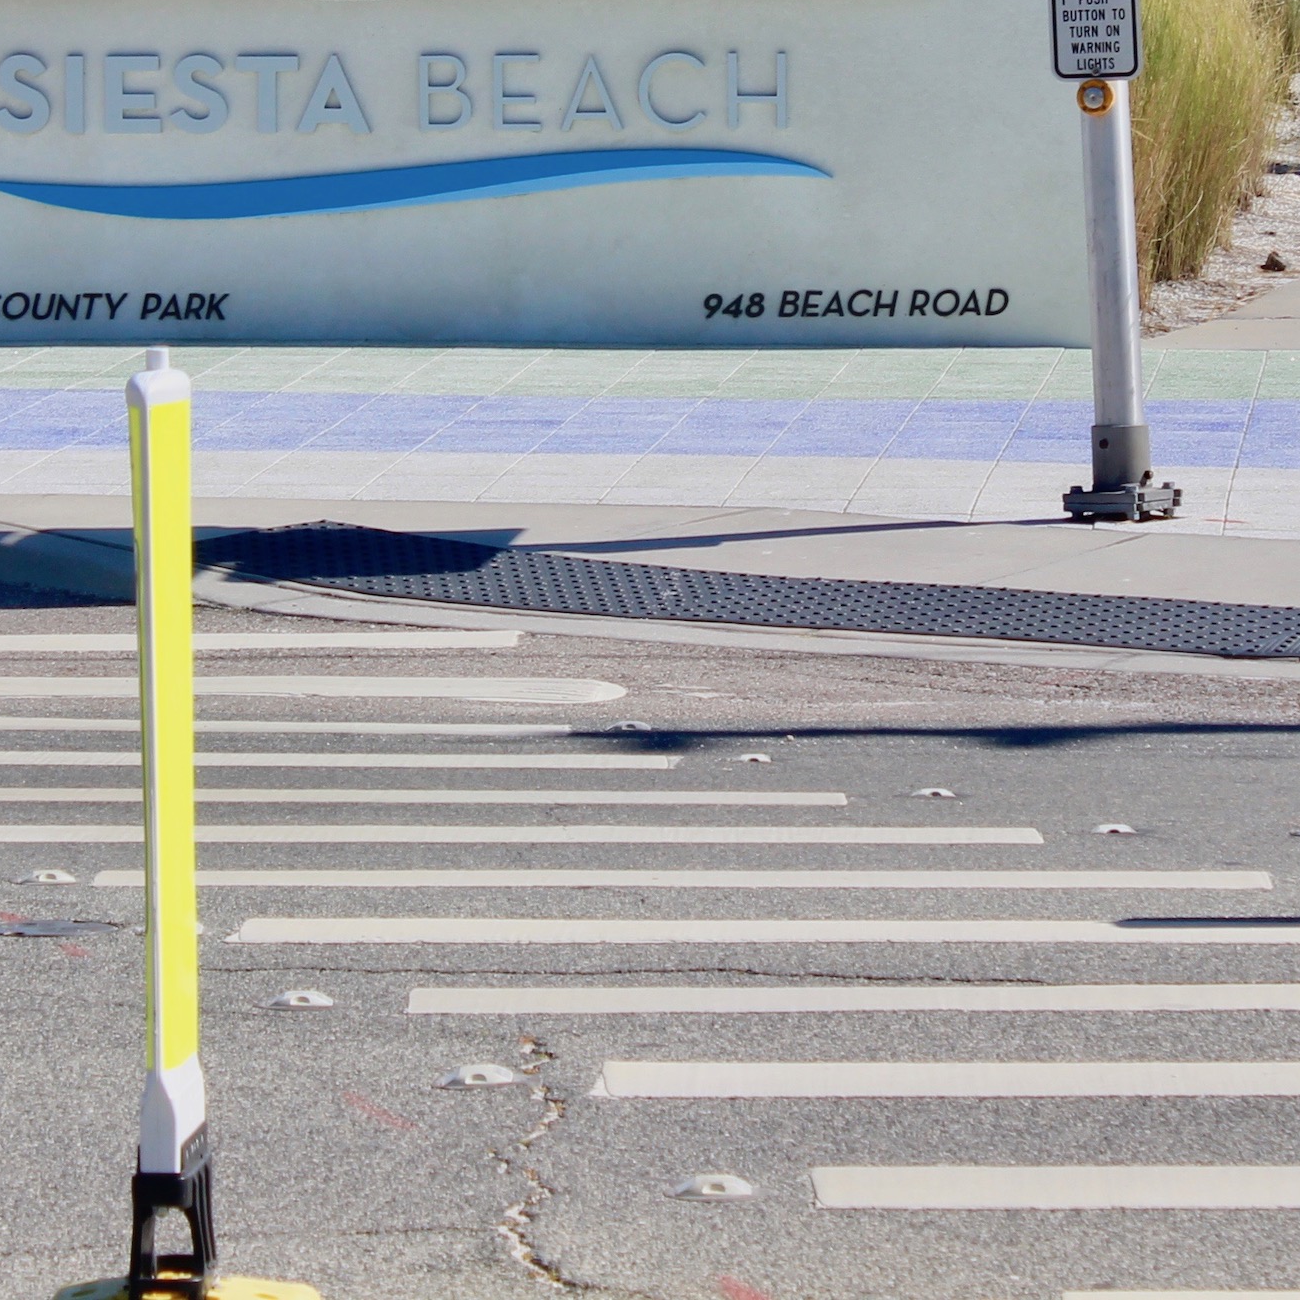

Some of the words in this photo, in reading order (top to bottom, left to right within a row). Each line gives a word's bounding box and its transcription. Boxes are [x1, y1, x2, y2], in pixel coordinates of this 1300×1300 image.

[1063, 9, 1105, 22] BUTTON
[1112, 8, 1125, 20] TO
[1070, 26, 1098, 38] TURN
[1106, 25, 1120, 37] ON
[1071, 41, 1120, 54] WARNING
[1077, 57, 1115, 70] LIGHTS
[418, 51, 788, 132] BEACH
[140, 293, 230, 321] PARK
[703, 293, 765, 319] 948
[778, 290, 899, 318] BEACH
[908, 288, 1009, 316] ROAD
